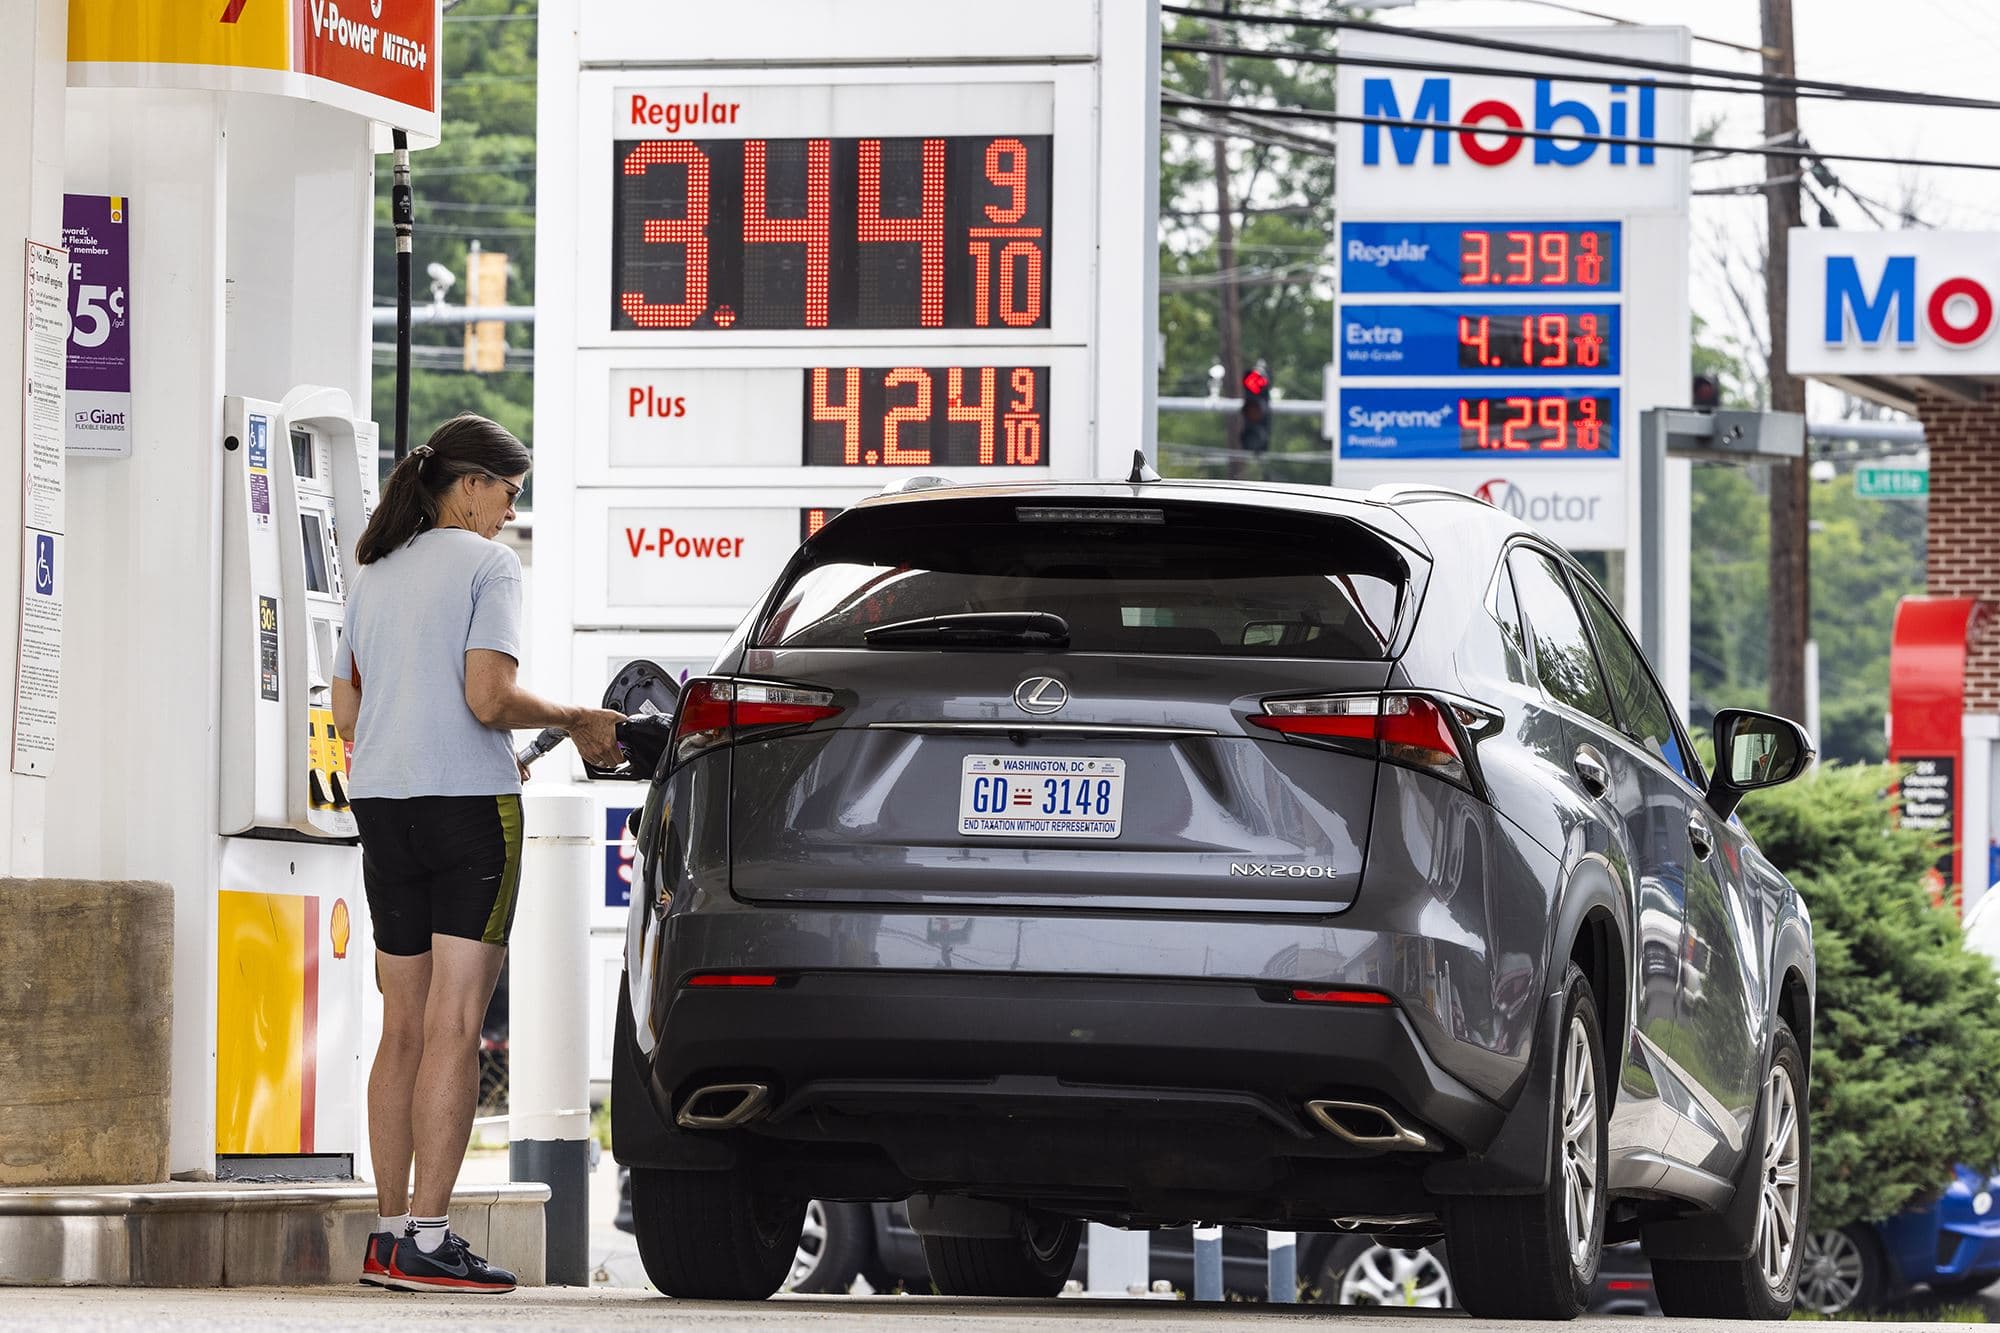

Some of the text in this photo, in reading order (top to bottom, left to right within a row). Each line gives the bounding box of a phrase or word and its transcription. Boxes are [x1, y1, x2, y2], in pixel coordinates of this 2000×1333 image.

[310, 0, 378, 55] V-Power
[631, 92, 740, 133] Regular
[1363, 78, 1656, 167] Mobil
[70, 236, 98, 245] Flexible
[622, 139, 945, 328] 3.44
[43, 255, 58, 269] smoking
[74, 246, 109, 255] members
[1348, 239, 1430, 267] Regular
[1462, 231, 1568, 285] 3.39
[1347, 323, 1403, 344] Extra
[1458, 313, 1568, 367] 4.19
[629, 386, 686, 417] Plus
[812, 367, 996, 465] 4.24
[75, 423, 125, 432] FLEXIBLE REWARDS
[90, 408, 125, 425] Giant
[1459, 396, 1568, 450] 4.29
[1347, 435, 1397, 447] Premium
[1861, 471, 1922, 493] Little
[626, 528, 744, 558] V-Power
[1004, 760, 1084, 773] WASHINGTON, DC
[973, 777, 1111, 815] GD 3148
[964, 820, 1115, 833] END TAXATION WITHOUT REPRESENTATION
